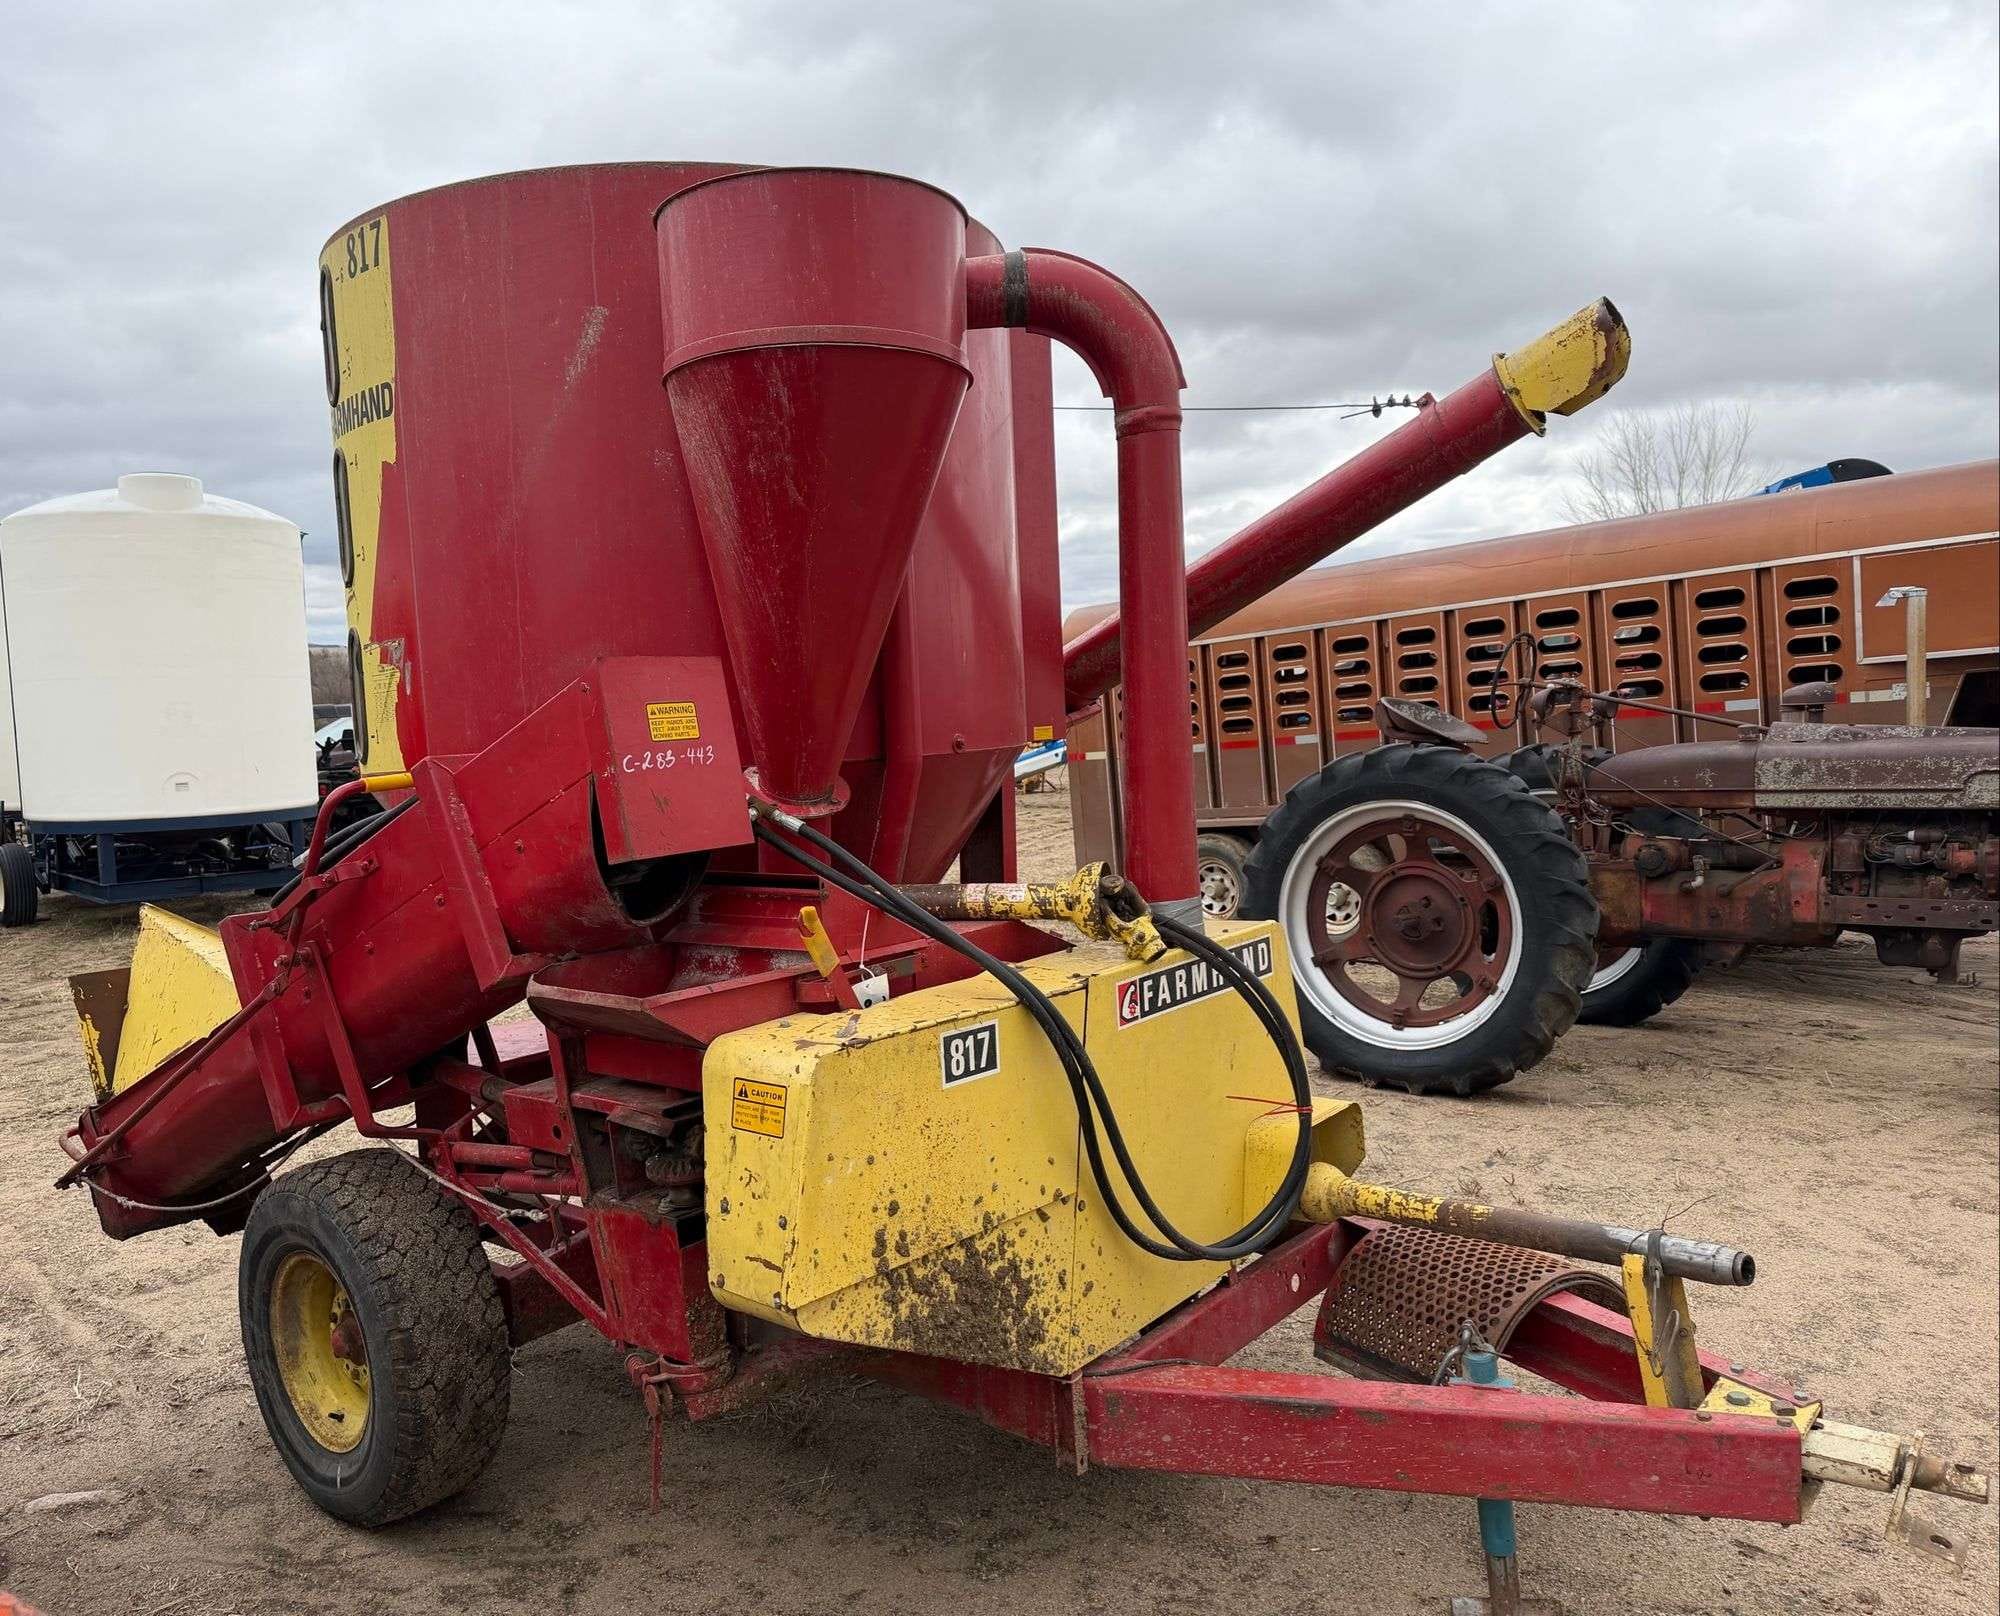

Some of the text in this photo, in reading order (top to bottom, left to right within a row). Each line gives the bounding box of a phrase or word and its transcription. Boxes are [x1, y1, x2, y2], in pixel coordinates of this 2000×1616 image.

[346, 219, 382, 279] 817
[331, 381, 394, 441] ARMHAND
[657, 705, 694, 715] WARNING
[950, 1031, 990, 1076] 817
[751, 1089, 783, 1101] CAUTION
